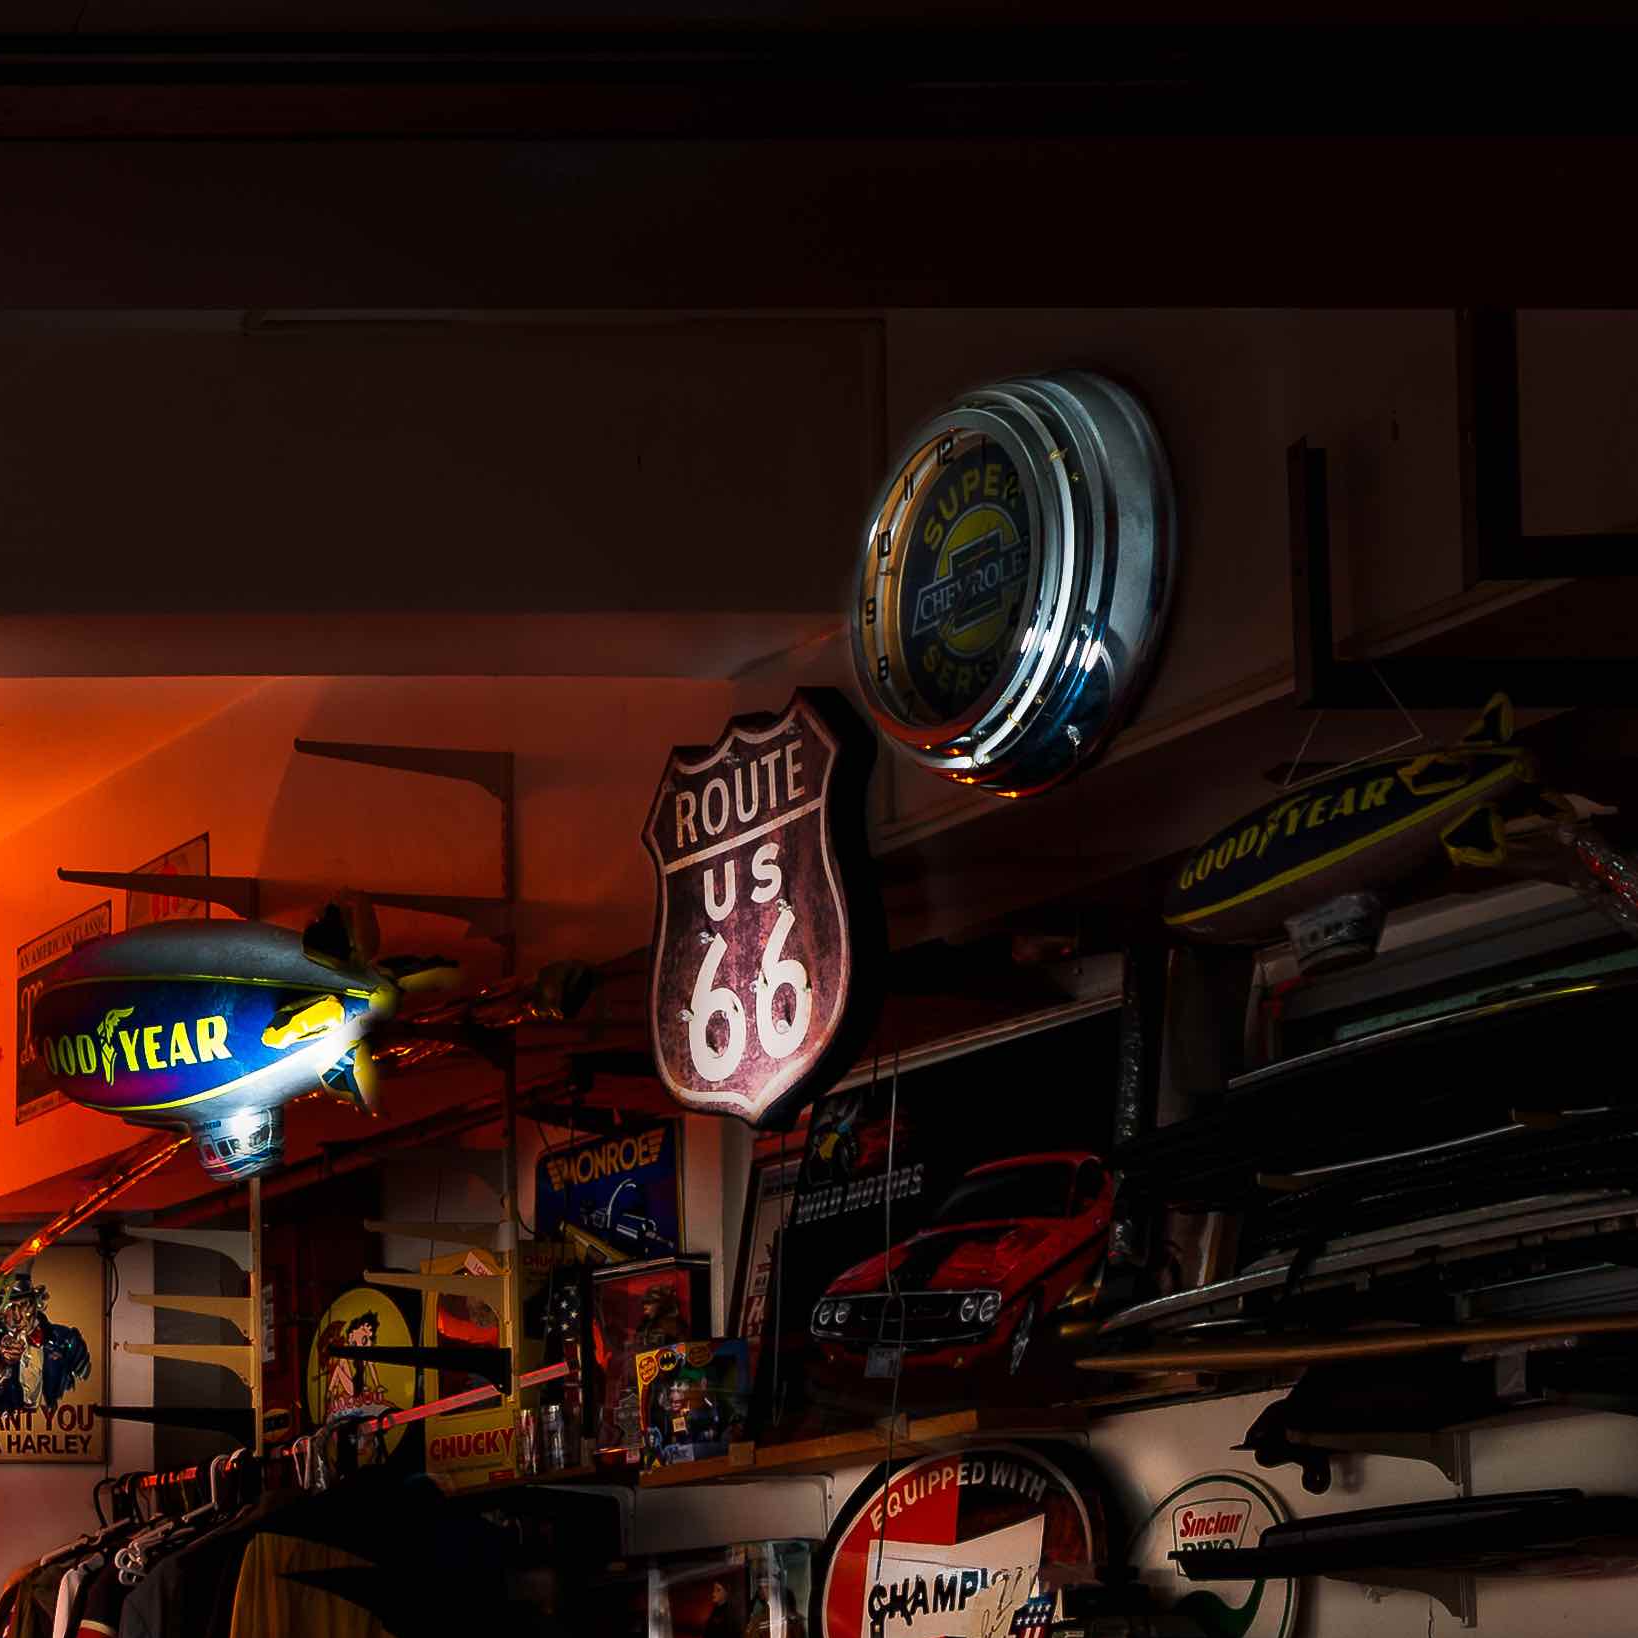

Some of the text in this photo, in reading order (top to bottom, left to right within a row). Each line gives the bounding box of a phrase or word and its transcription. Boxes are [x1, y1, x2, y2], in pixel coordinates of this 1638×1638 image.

[676, 741, 805, 848] ROUTE
[703, 842, 781, 922] US
[688, 904, 812, 1082] 66
[563, 1134, 652, 1185] MONROE
[40, 1403, 95, 1432] YOU
[7, 1434, 93, 1454] HARLEY
[430, 1427, 516, 1460] CHUCKY
[868, 1462, 1048, 1532] EQUIPPED WITH
[1179, 1510, 1243, 1537] Sinclair
